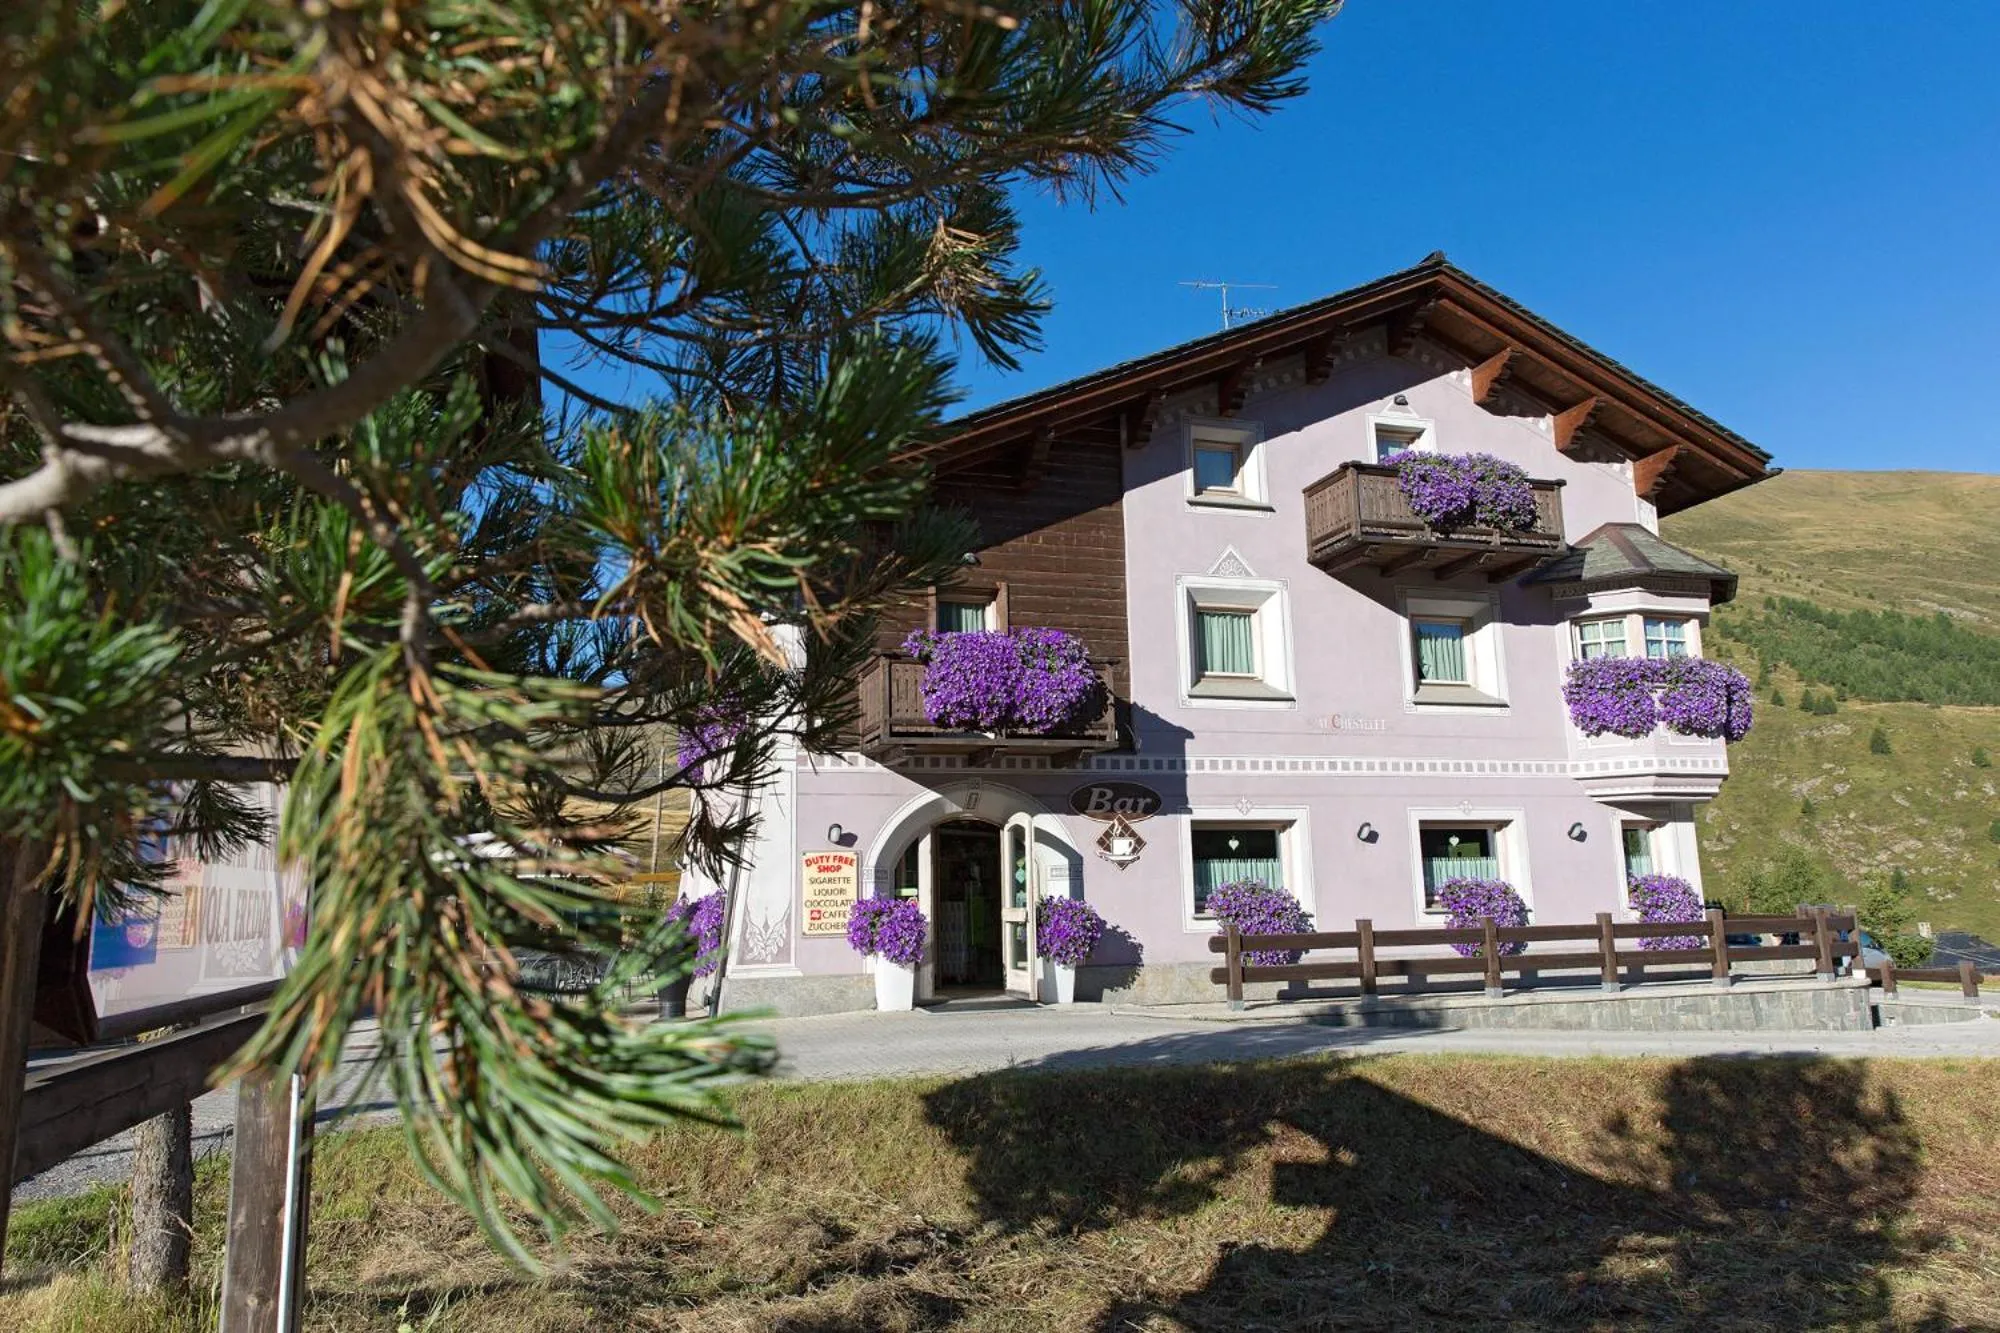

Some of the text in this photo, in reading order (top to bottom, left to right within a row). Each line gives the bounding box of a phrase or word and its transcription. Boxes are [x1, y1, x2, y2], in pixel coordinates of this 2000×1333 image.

[1084, 787, 1153, 814] Bar
[804, 855, 856, 867] DUTY FREE
[817, 864, 842, 873] SHOP
[809, 876, 851, 885] SIGARETTE
[813, 887, 847, 896] LIQUORI
[808, 921, 848, 931] ZUCCHER
